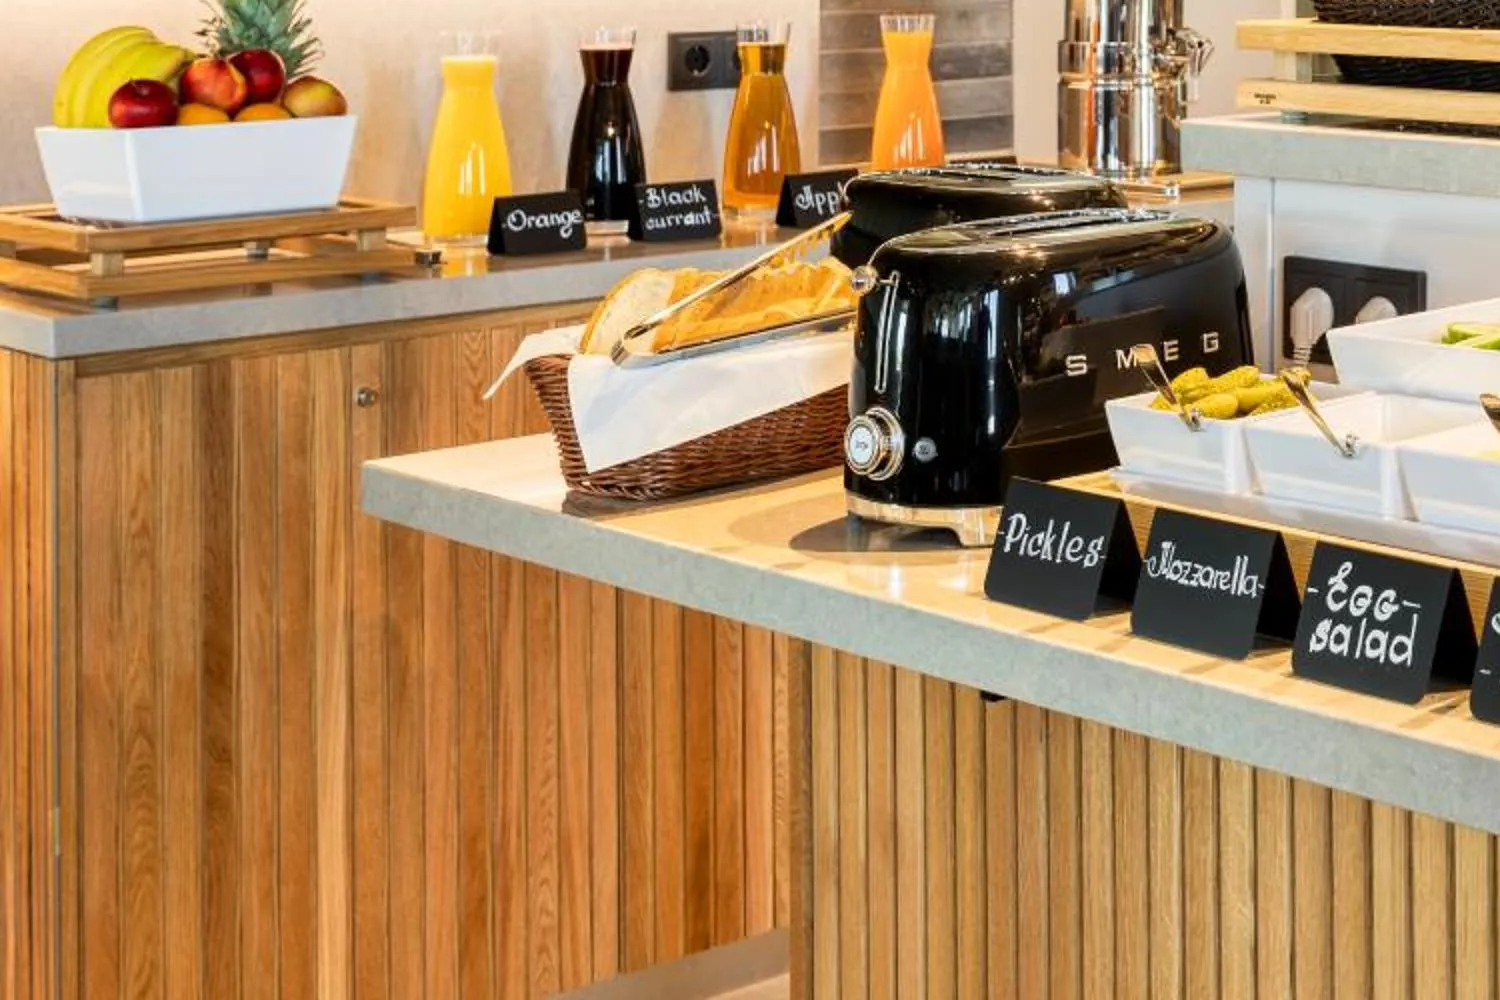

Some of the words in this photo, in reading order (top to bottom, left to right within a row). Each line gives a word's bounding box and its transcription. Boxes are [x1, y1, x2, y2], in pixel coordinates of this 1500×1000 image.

[795, 180, 849, 215] Appl
[1065, 331, 1220, 377] SMEG
[1309, 613, 1419, 667] salad
